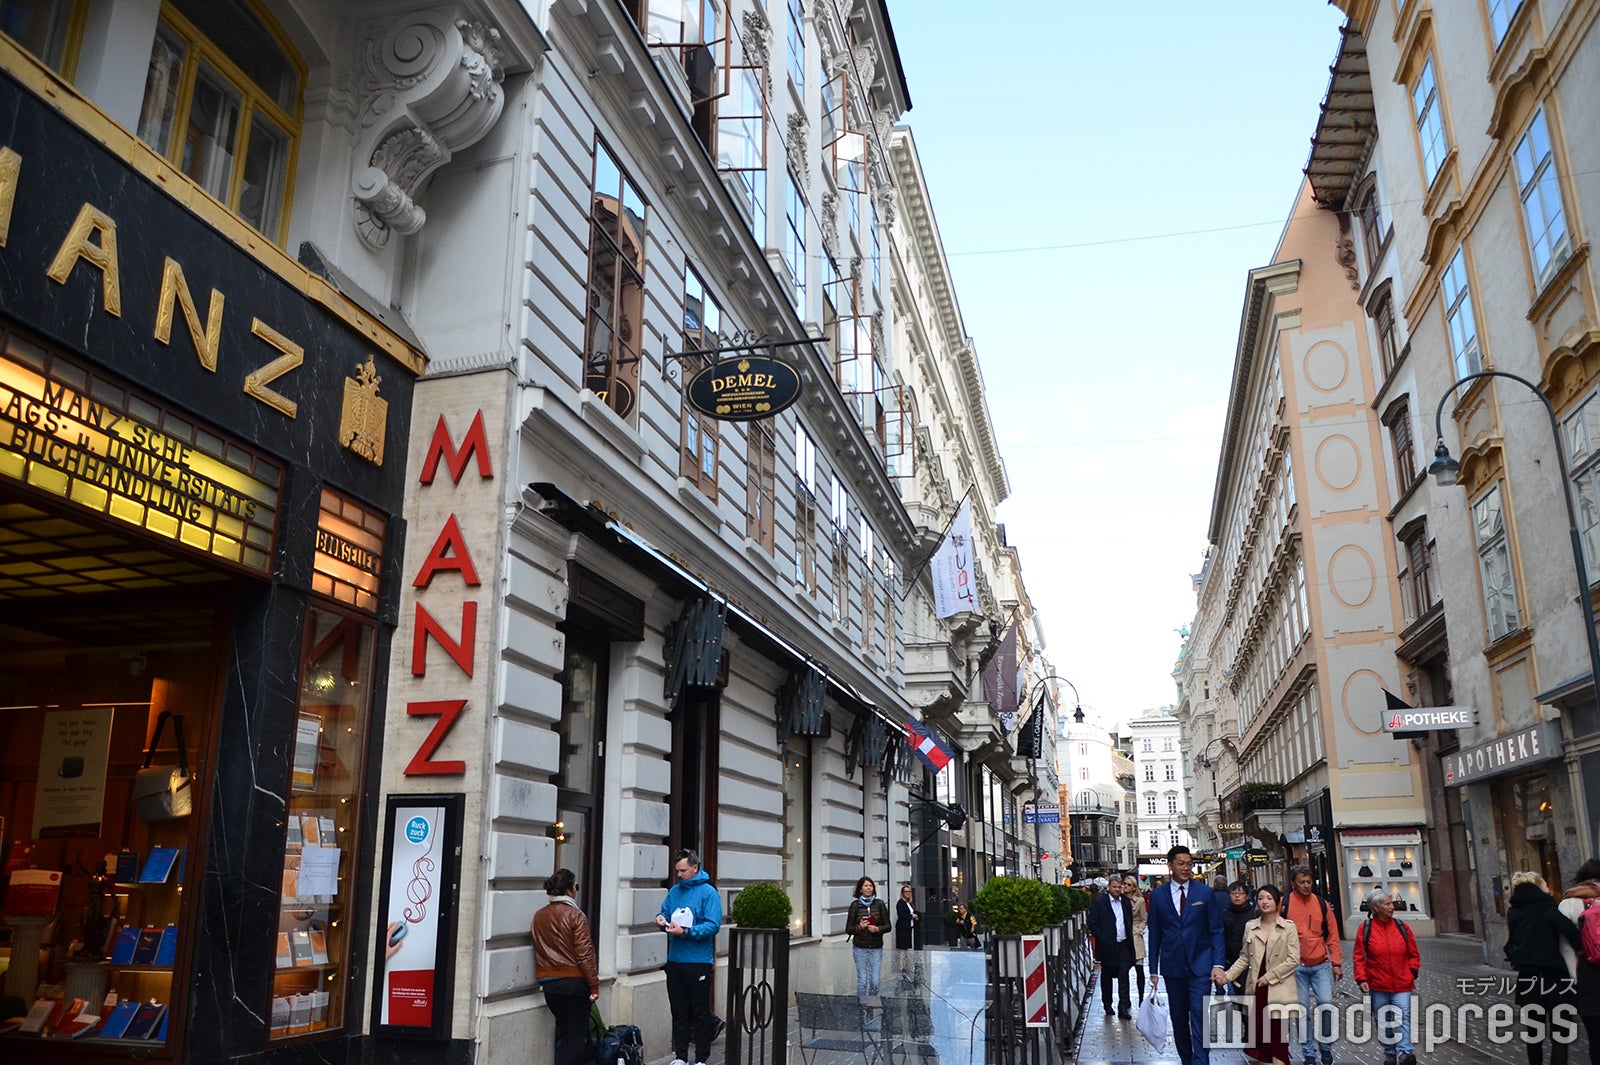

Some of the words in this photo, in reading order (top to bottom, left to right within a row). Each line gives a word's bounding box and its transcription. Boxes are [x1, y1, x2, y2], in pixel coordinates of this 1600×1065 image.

[711, 374, 776, 392] DEMEL
[0, 393, 68, 434] AGS-
[10, 426, 202, 521] BUCHHANDLUNG
[402, 408, 494, 777] MANZ
[1388, 711, 1469, 729] APOTHEKE
[1458, 729, 1540, 777] APOTHEKE
[410, 829, 425, 837] zuck
[411, 820, 426, 830] Ruck
